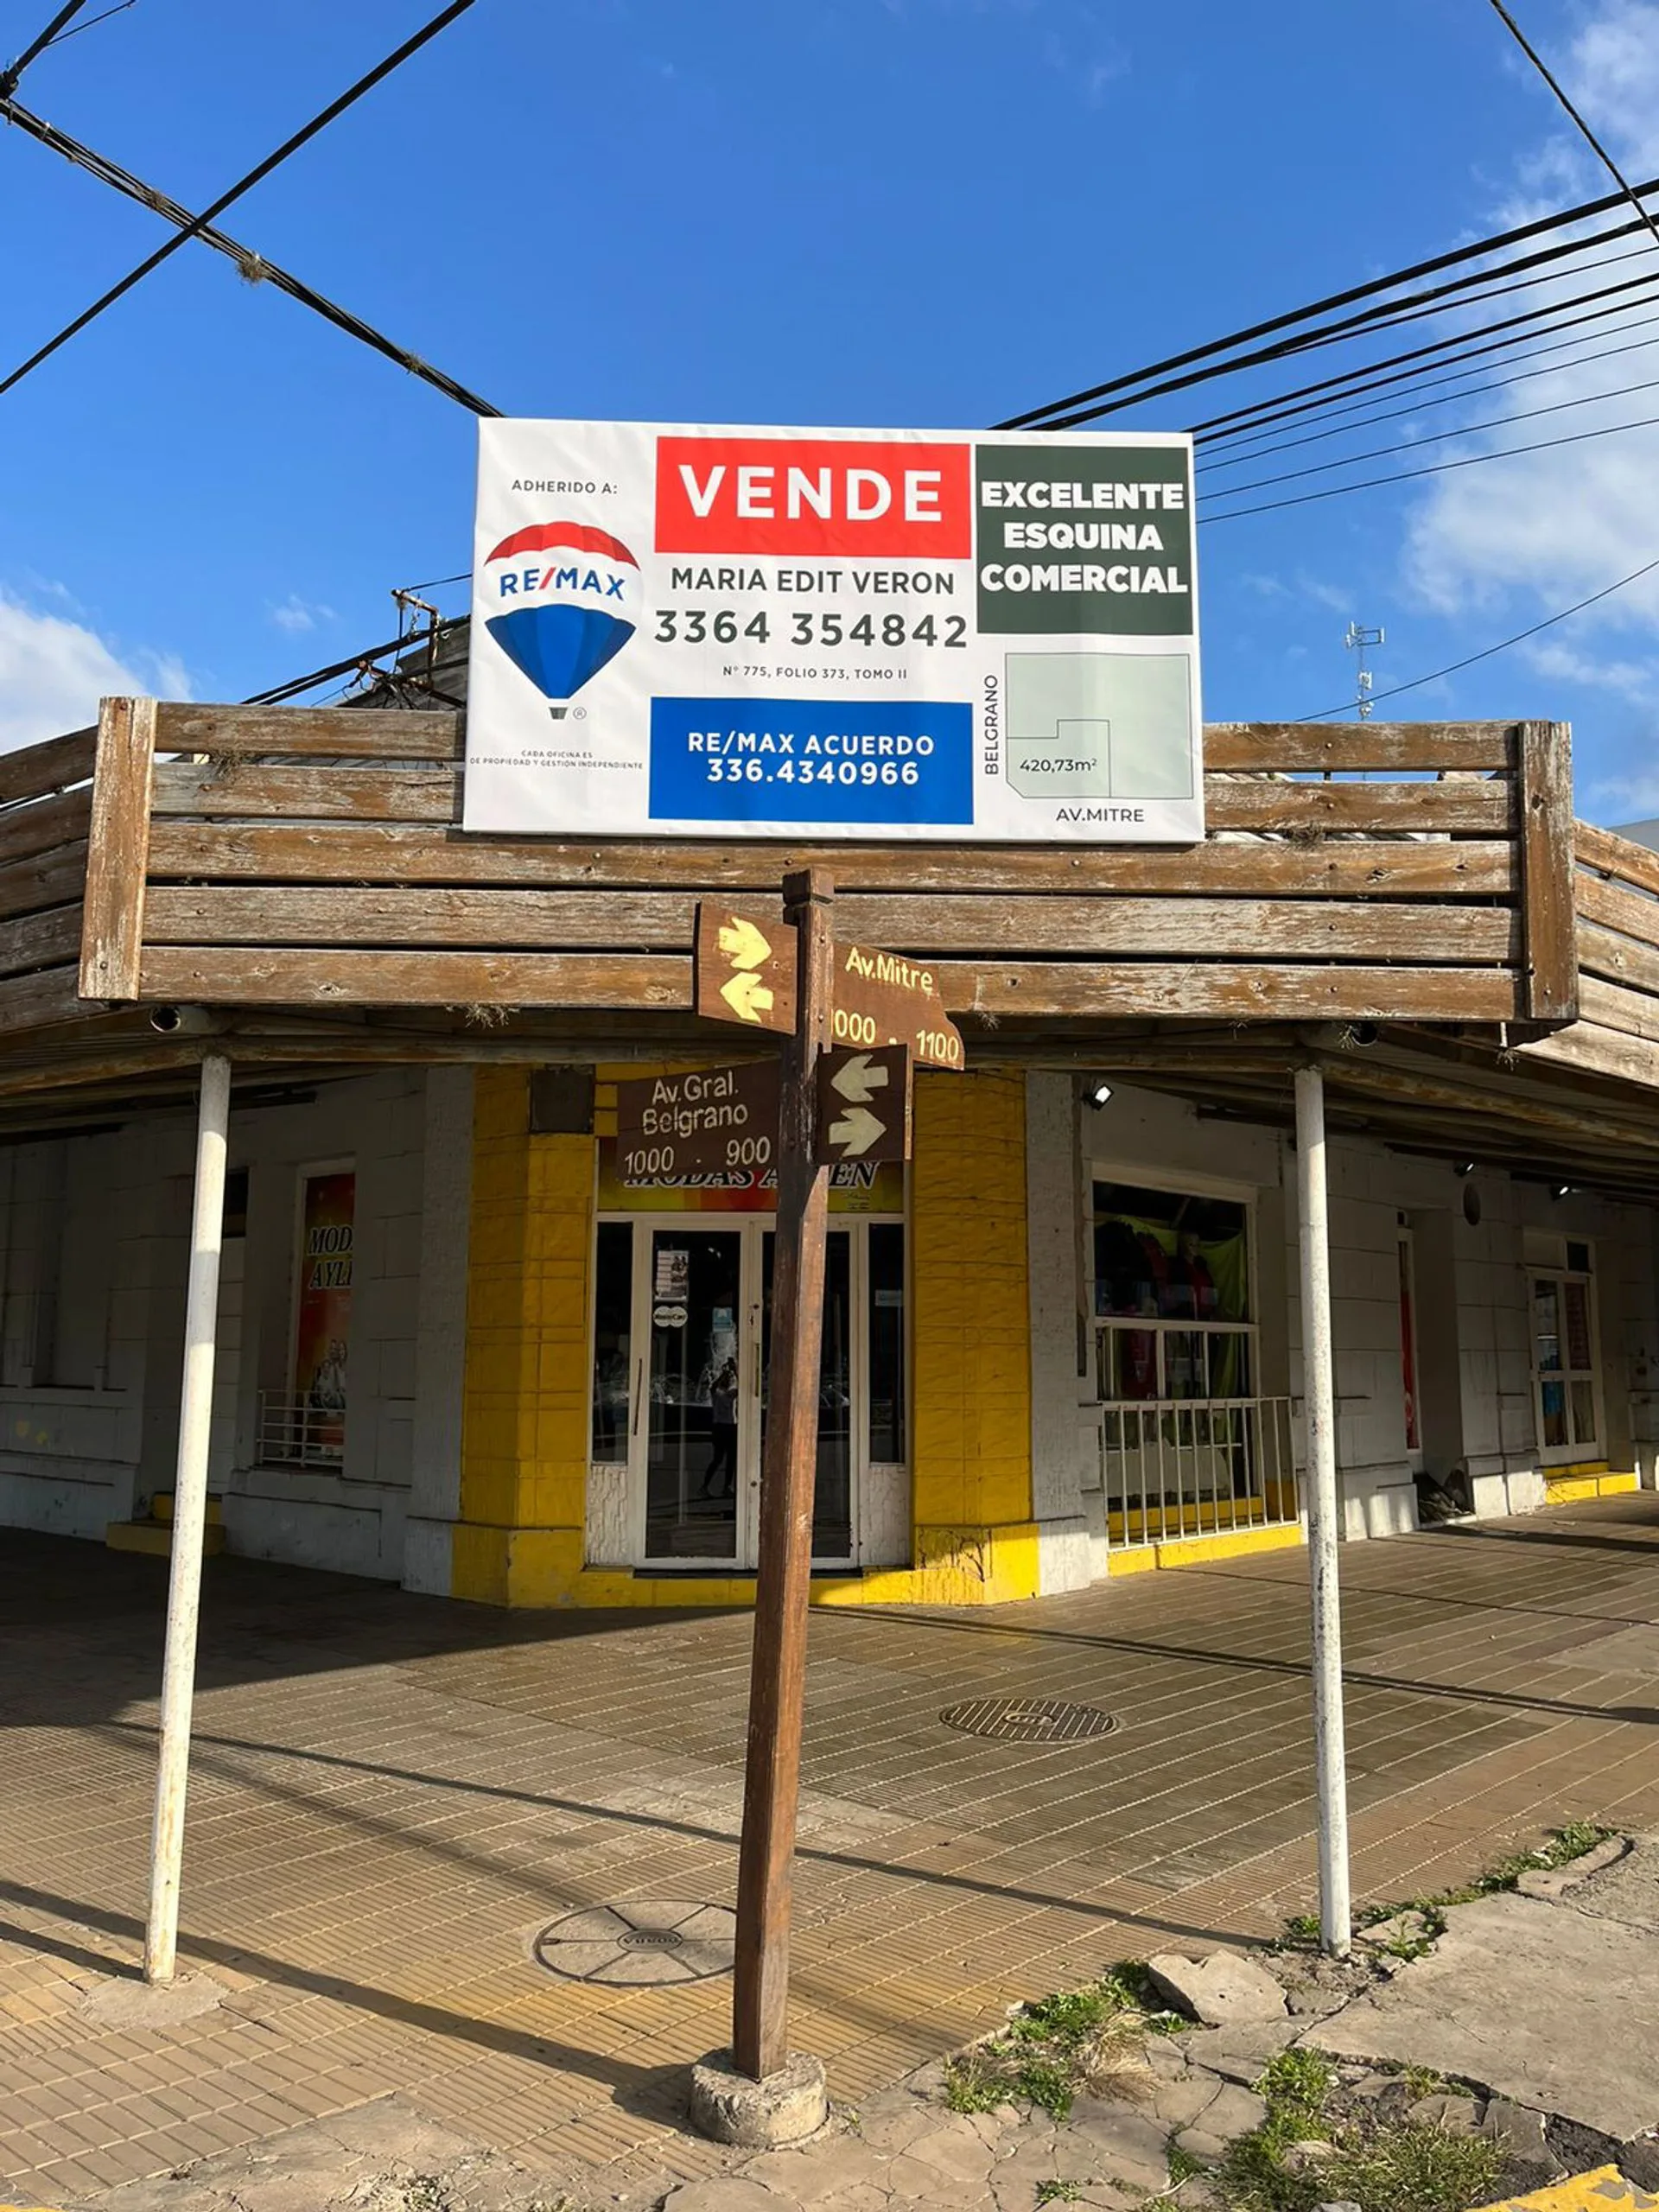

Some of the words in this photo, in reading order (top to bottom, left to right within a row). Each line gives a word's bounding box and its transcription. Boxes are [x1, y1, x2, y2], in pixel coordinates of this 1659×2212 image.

[512, 480, 596, 493] ADHERIDO
[601, 482, 618, 494] A:
[678, 465, 941, 522] VENDE
[982, 481, 1185, 509] EXCELENTE
[1004, 522, 1164, 550] ESQUINA
[499, 567, 625, 601] RE/MAX
[671, 568, 767, 590] MARIA
[778, 570, 843, 594] EDIT
[852, 572, 954, 594] VERON
[981, 564, 1188, 593] COMERCIAL
[654, 610, 770, 644] 3364
[791, 613, 967, 648] 354842
[744, 666, 772, 678] 775,
[776, 668, 817, 679] FOLIO
[822, 669, 849, 680] 373,
[854, 669, 893, 679] TOMO
[898, 670, 907, 679] II
[983, 675, 999, 775] BELGRANO
[689, 731, 794, 754] RE/MAX
[804, 735, 934, 755] ACUERDO
[578, 760, 643, 769] INDEPENDIENTE
[707, 759, 919, 785] 336.4340966
[1056, 808, 1145, 822] AV.MITRE
[916, 1029, 959, 1062] 1100
[643, 1104, 748, 1138] Belgrano
[625, 1146, 675, 1175] 1000
[726, 1135, 771, 1166] 900
[307, 1224, 353, 1255] MOD
